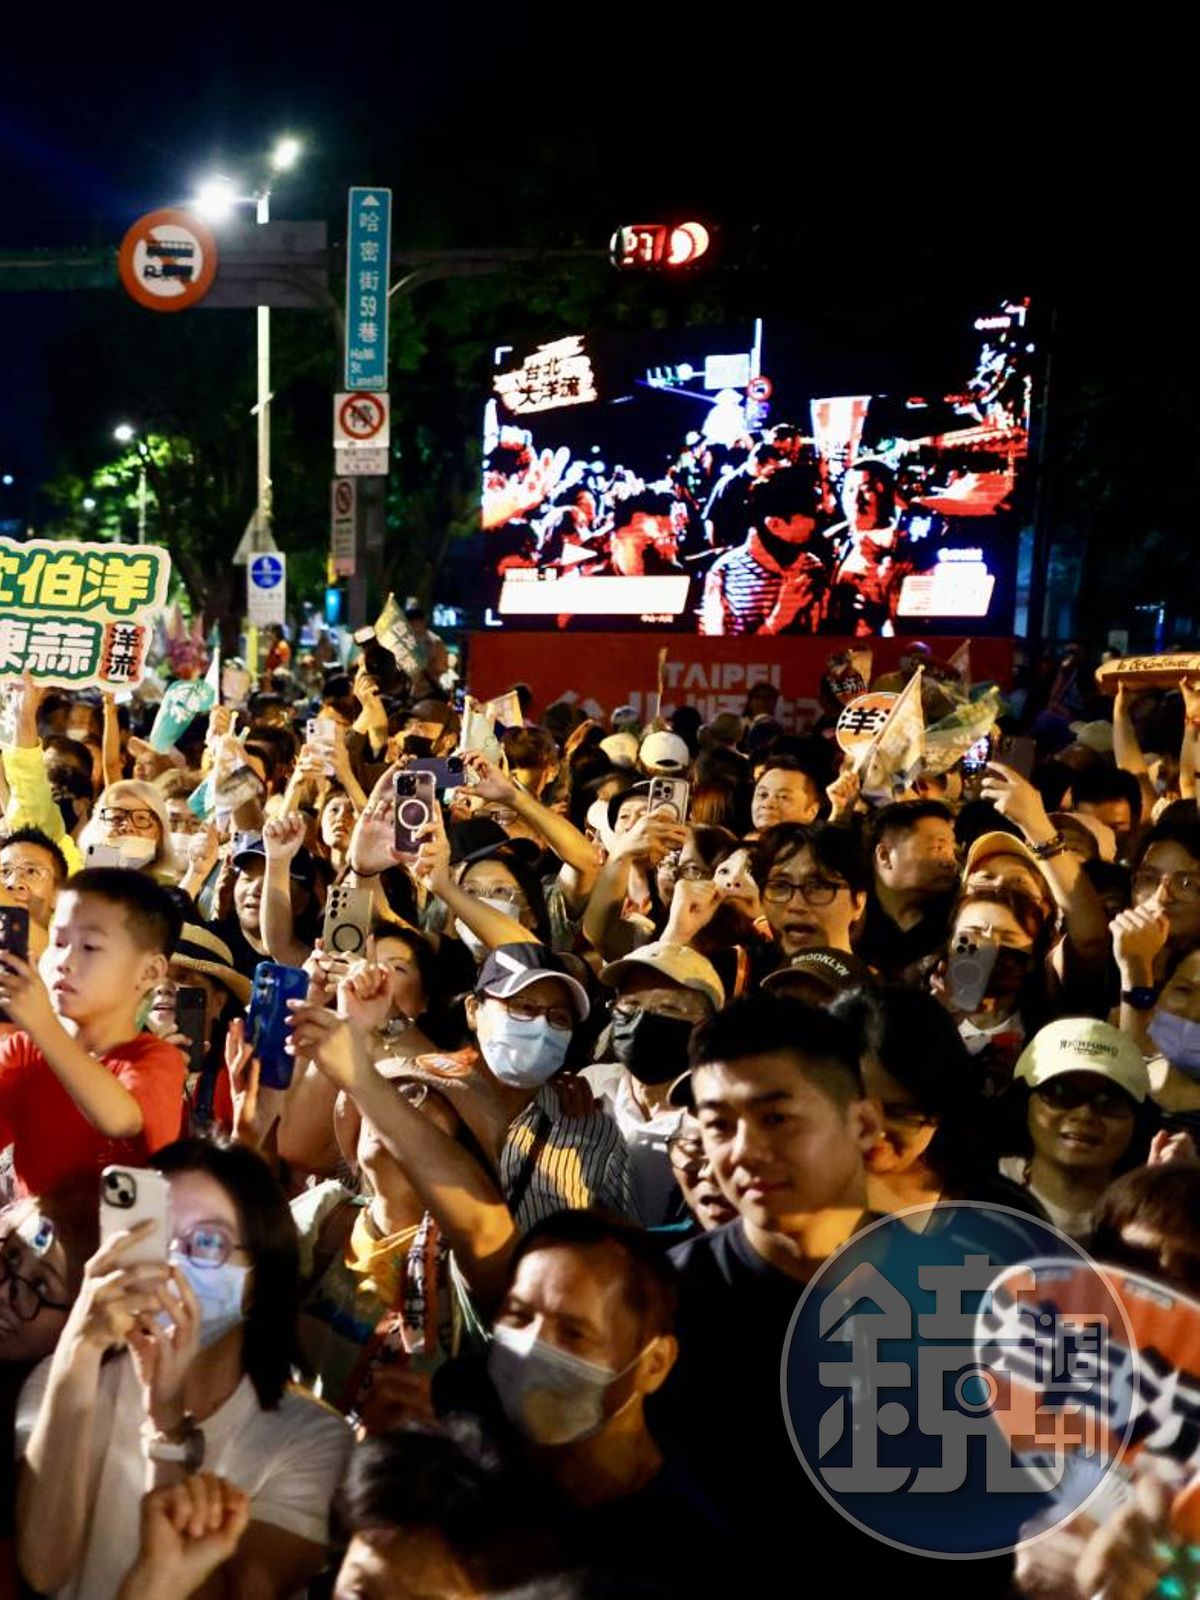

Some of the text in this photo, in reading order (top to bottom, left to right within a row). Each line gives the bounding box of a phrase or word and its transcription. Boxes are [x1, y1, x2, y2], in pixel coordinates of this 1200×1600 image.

[358, 211, 381, 343] 哈密街59巷
[109, 622, 140, 677] 洋流
[665, 660, 782, 690] TAIPEI
[791, 952, 850, 977] BROOKLYN
